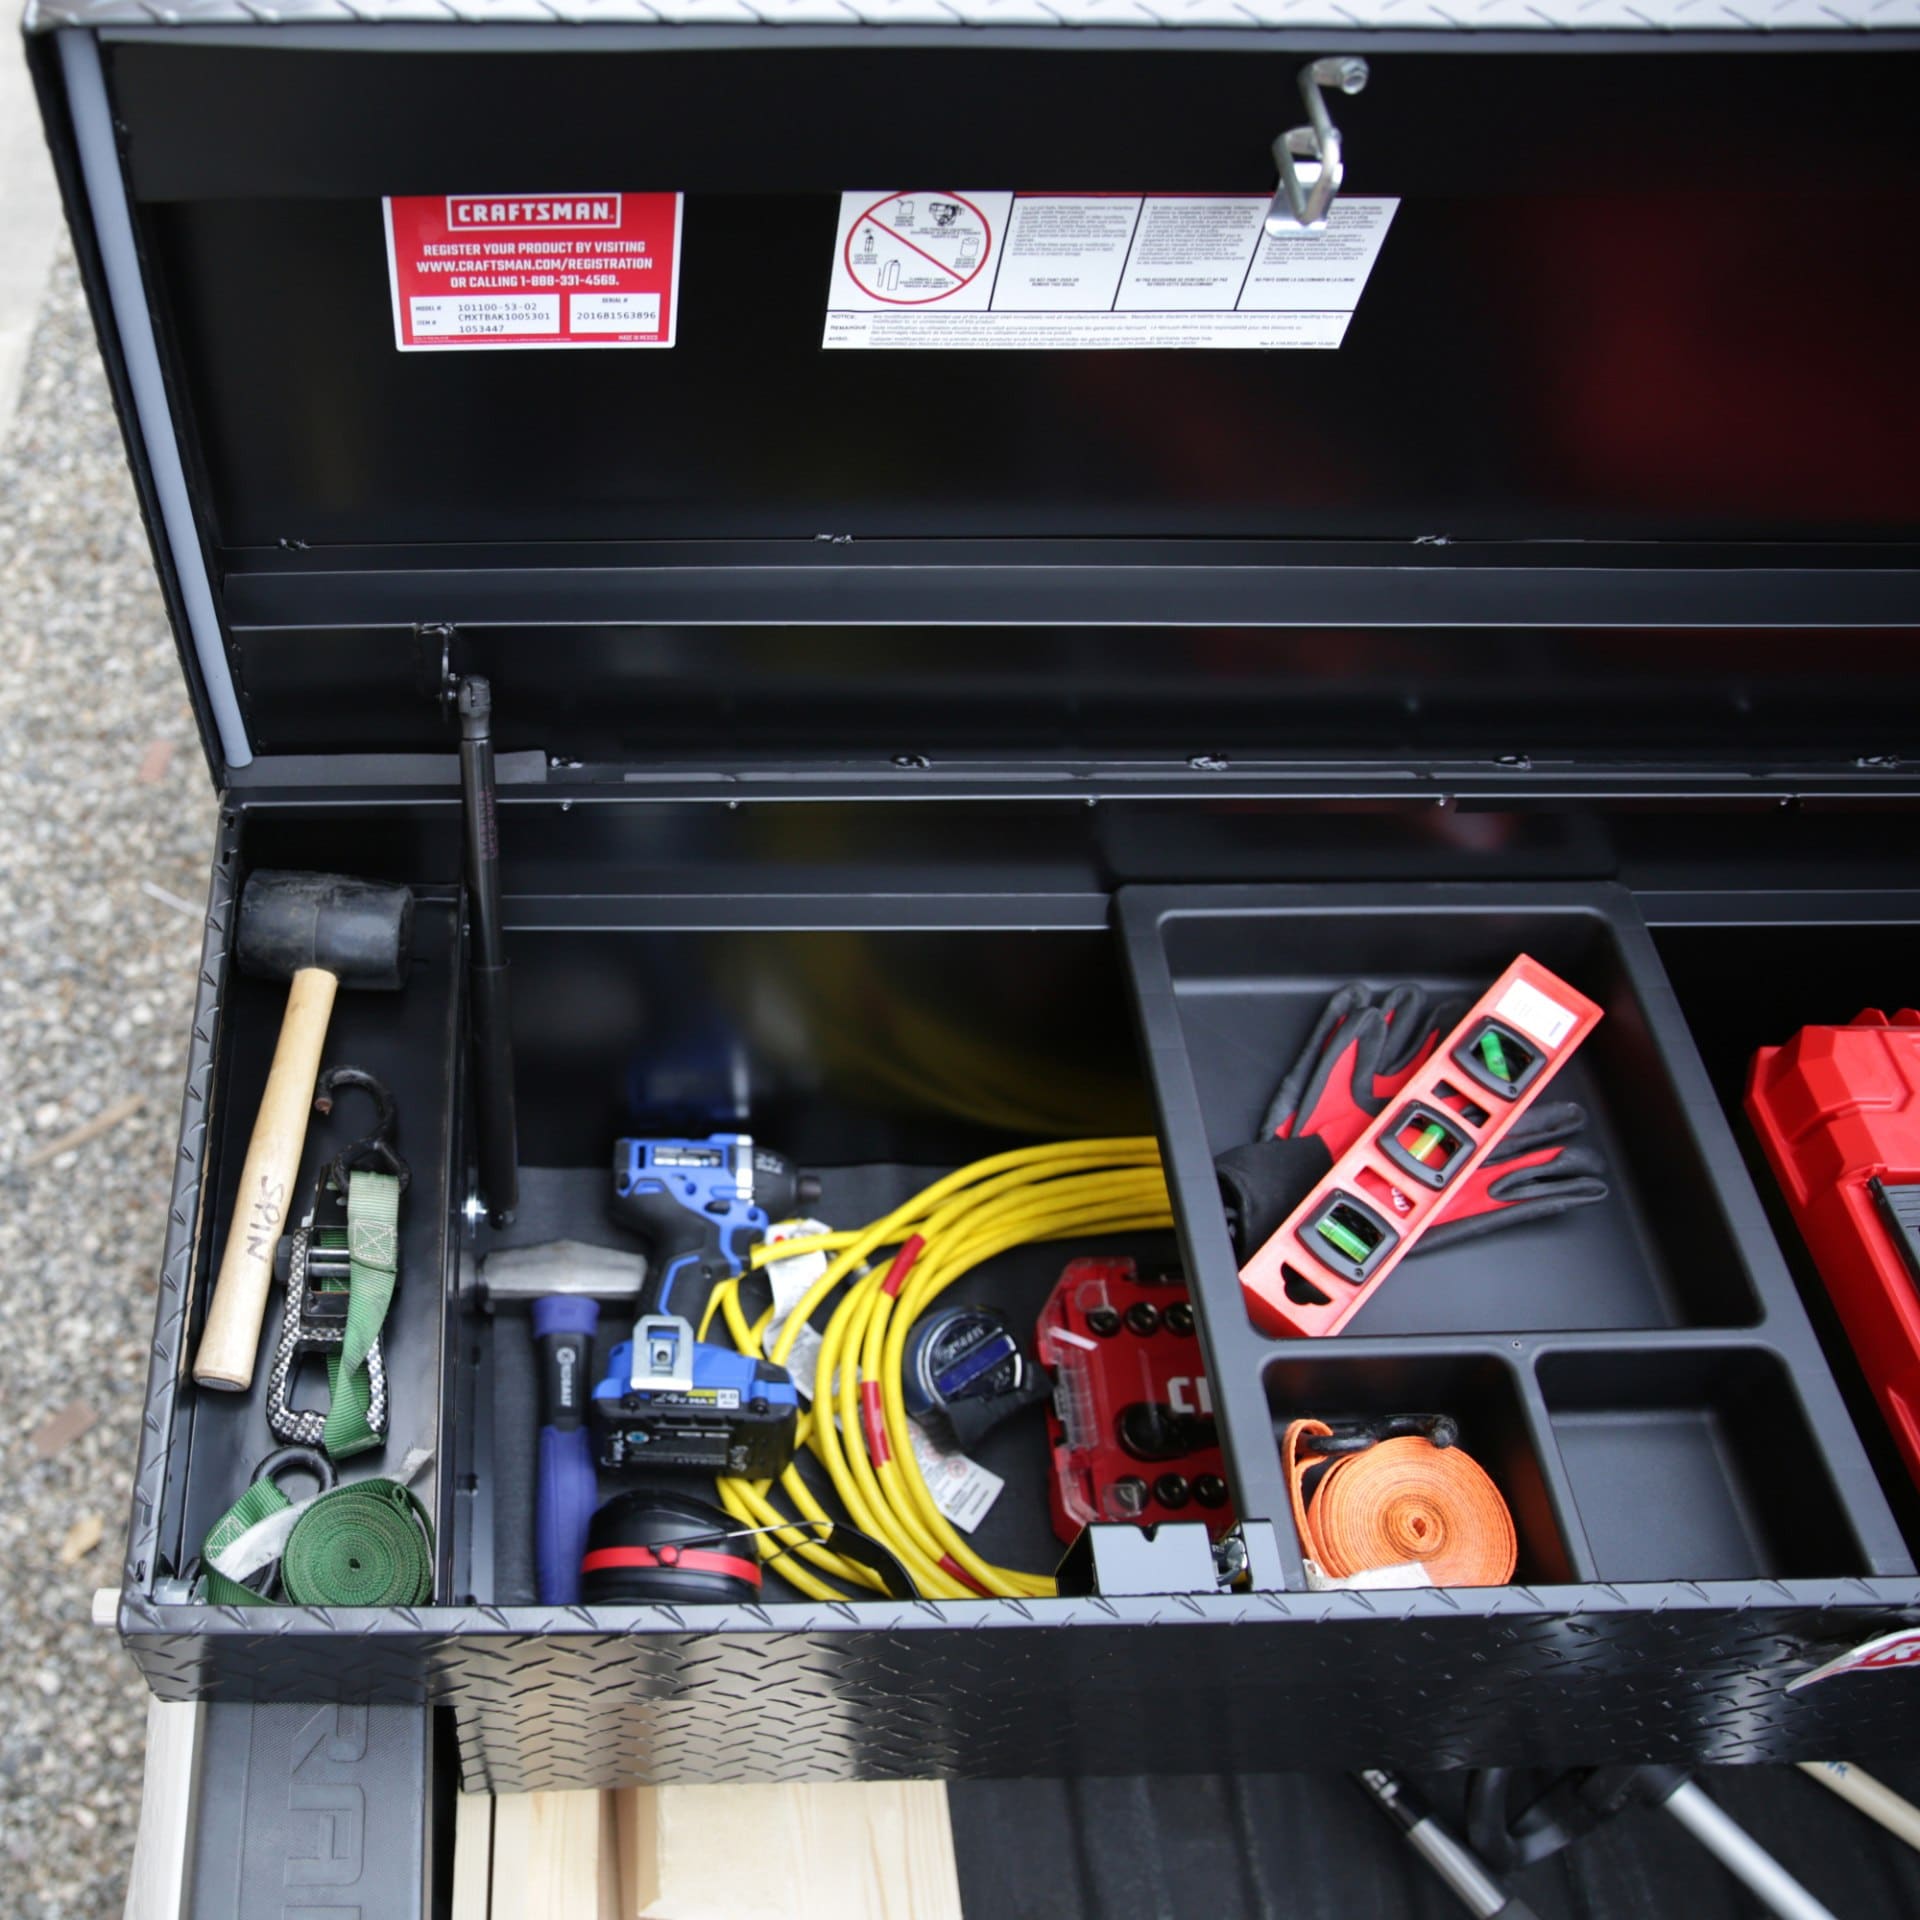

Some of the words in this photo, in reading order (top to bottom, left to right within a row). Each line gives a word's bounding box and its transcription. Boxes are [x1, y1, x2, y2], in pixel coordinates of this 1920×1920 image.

[458, 202, 609, 222] CRAFTSMAN
[424, 244, 480, 256] REGISTER
[484, 243, 517, 255] YOUR
[518, 243, 573, 254] PRODUCT
[576, 242, 592, 253] BY
[594, 241, 645, 253] VISITING
[417, 258, 653, 272] WWW.CRAFTSMAN.COM/REGISTRATION
[451, 277, 467, 288] OR
[469, 276, 518, 288] CALLING
[458, 303, 537, 312] 101100-53-02
[458, 312, 550, 321] CMXTBAK1005301
[460, 325, 504, 333] 1053447
[247, 1175, 284, 1263] SPIN
[283, 1702, 370, 1920] RA
